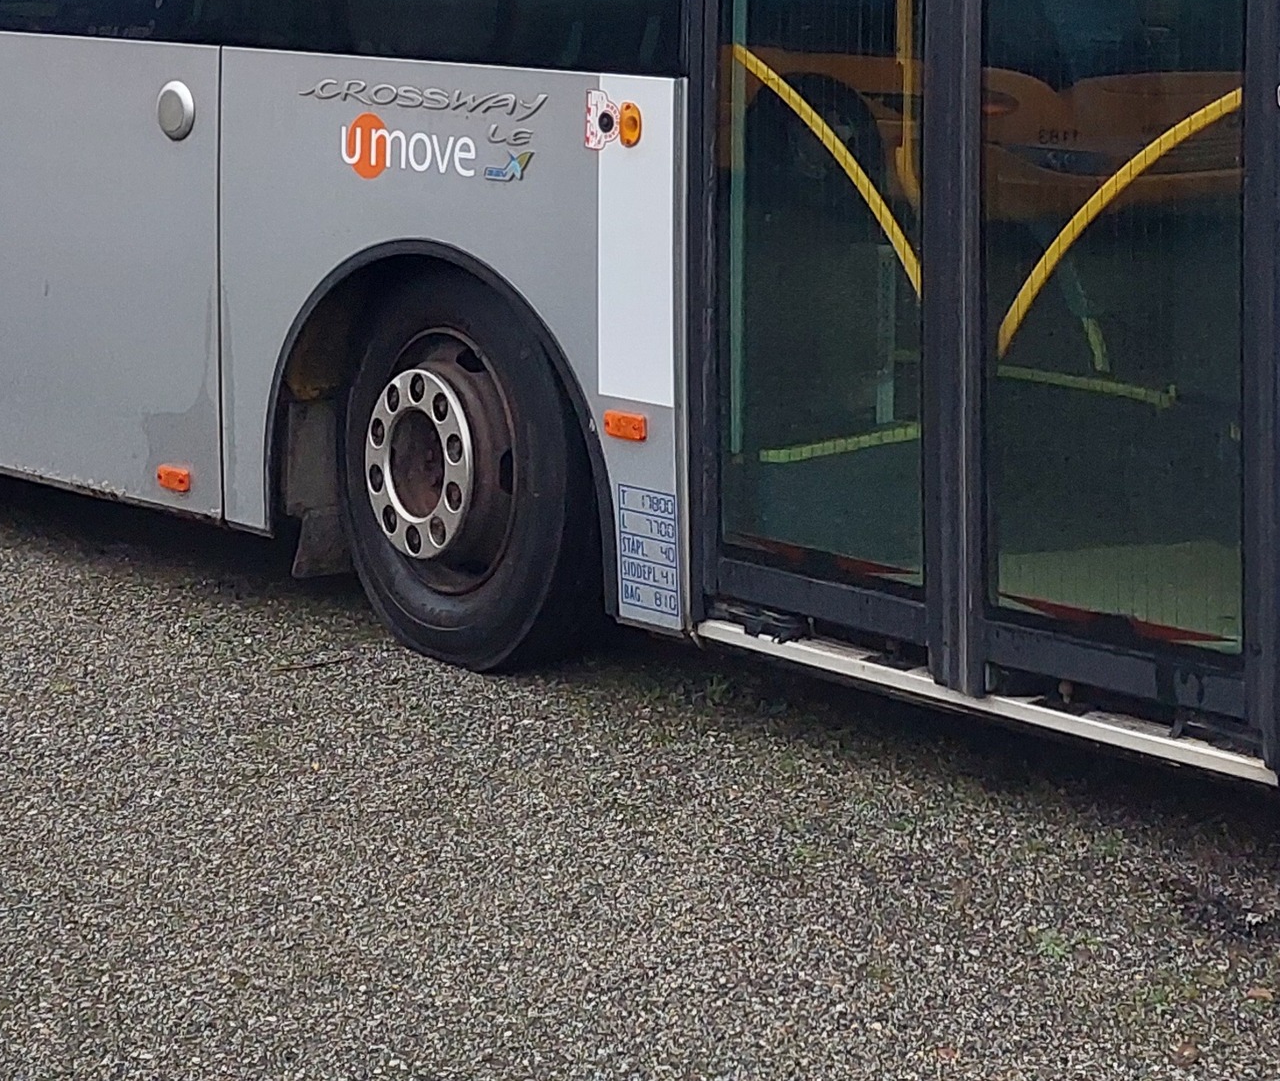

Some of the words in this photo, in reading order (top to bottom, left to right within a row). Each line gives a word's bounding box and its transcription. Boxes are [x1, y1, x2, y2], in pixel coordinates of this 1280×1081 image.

[298, 78, 549, 122] CROSSWAY
[486, 123, 534, 147] LE
[340, 125, 476, 177] umove
[621, 489, 628, 505] T
[622, 512, 628, 529] L
[660, 545, 675, 563] 40
[660, 569, 675, 586] 41
